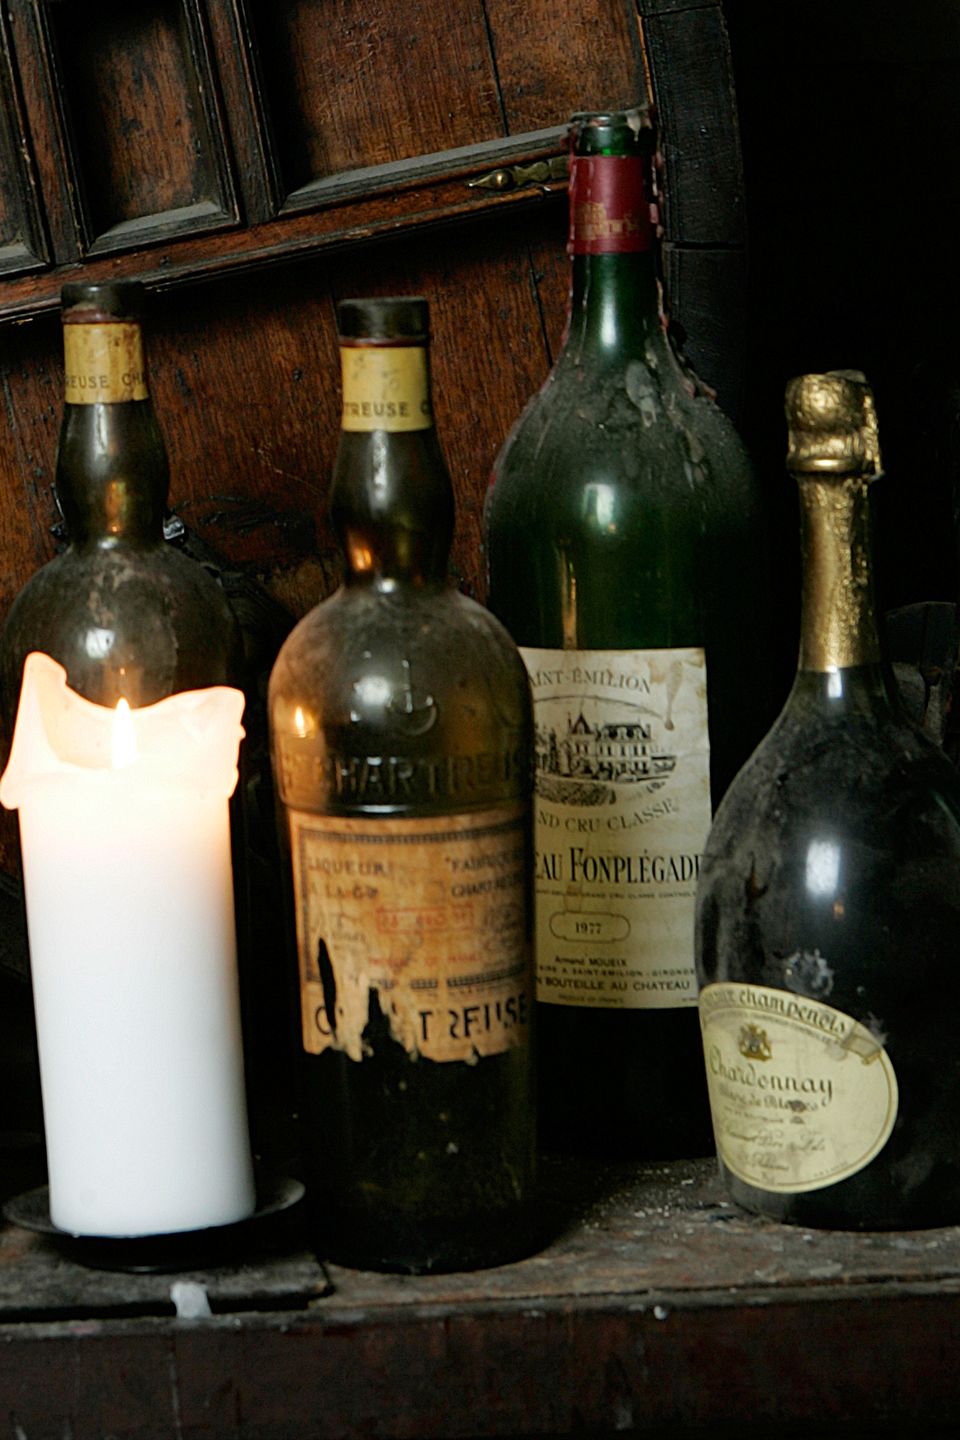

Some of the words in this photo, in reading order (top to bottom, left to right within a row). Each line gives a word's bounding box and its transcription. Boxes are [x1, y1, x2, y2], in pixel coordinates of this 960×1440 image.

[528, 668, 651, 695] AINT-ÉMILION
[564, 816, 601, 833] CRU
[575, 921, 603, 935] 1977
[545, 977, 605, 991] BOUTEILLE
[610, 980, 629, 991] AU
[632, 980, 691, 991] CHATEAU
[709, 1044, 833, 1108] Chardonnay
